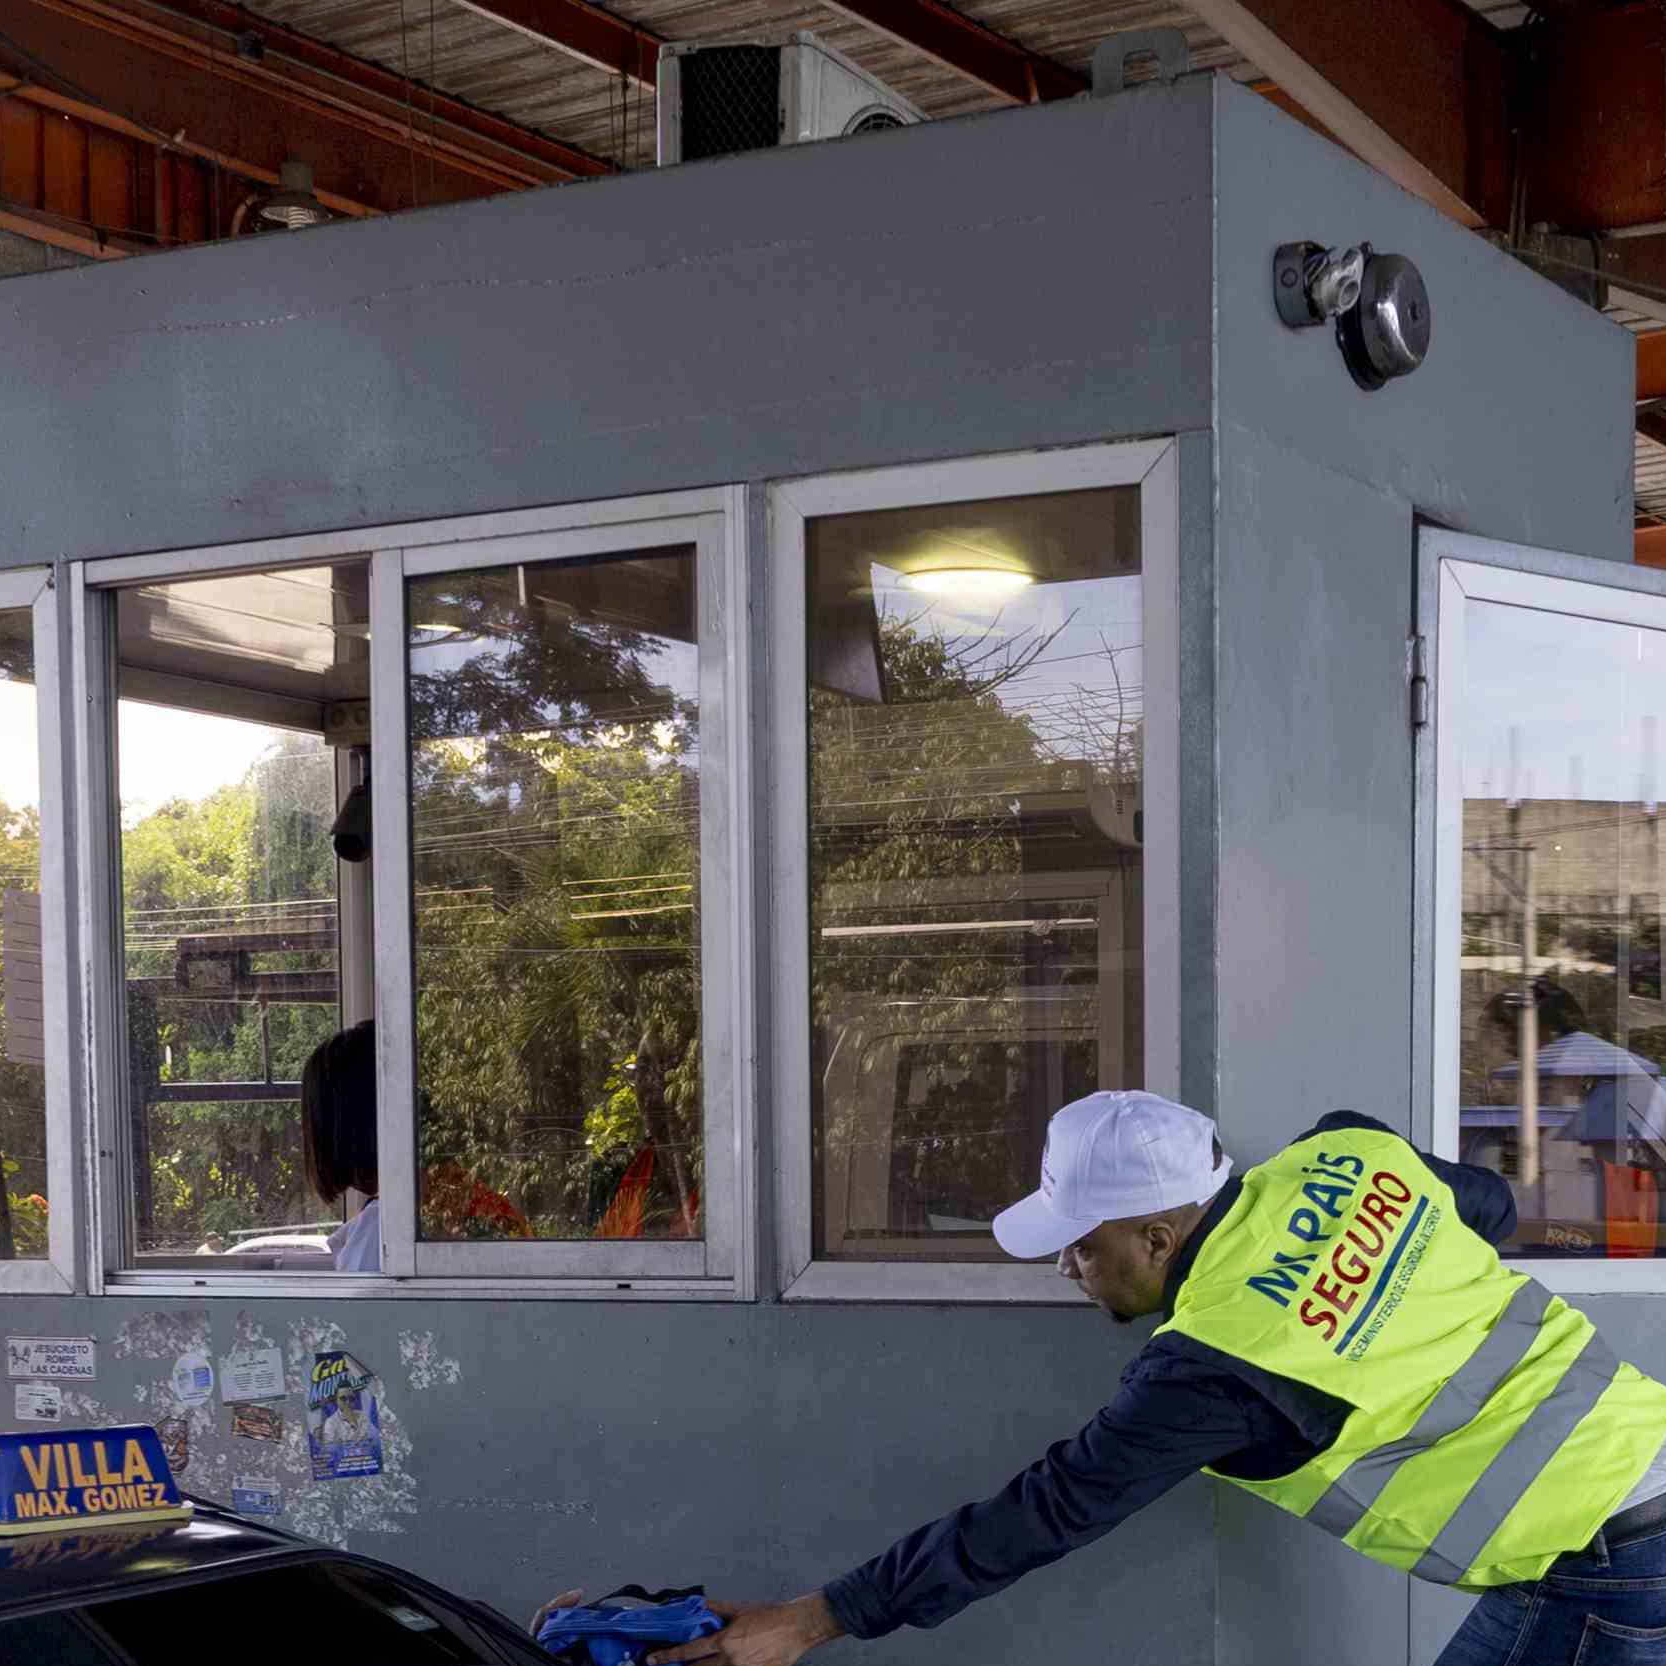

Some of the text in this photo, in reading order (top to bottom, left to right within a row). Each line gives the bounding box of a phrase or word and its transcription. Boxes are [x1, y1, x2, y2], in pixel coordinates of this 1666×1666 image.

[1299, 1171, 1412, 1342] SEGURO
[1398, 1238, 1428, 1285] SEGURIDAD
[1245, 1251, 1318, 1308] MI
[34, 1344, 89, 1354] JESUCRISTO
[45, 1355, 77, 1364] ROMPE
[30, 1365, 93, 1375] LAS CADENAS
[20, 1439, 154, 1491] VILLA
[15, 1483, 168, 1518] MAX. GOMEZ
